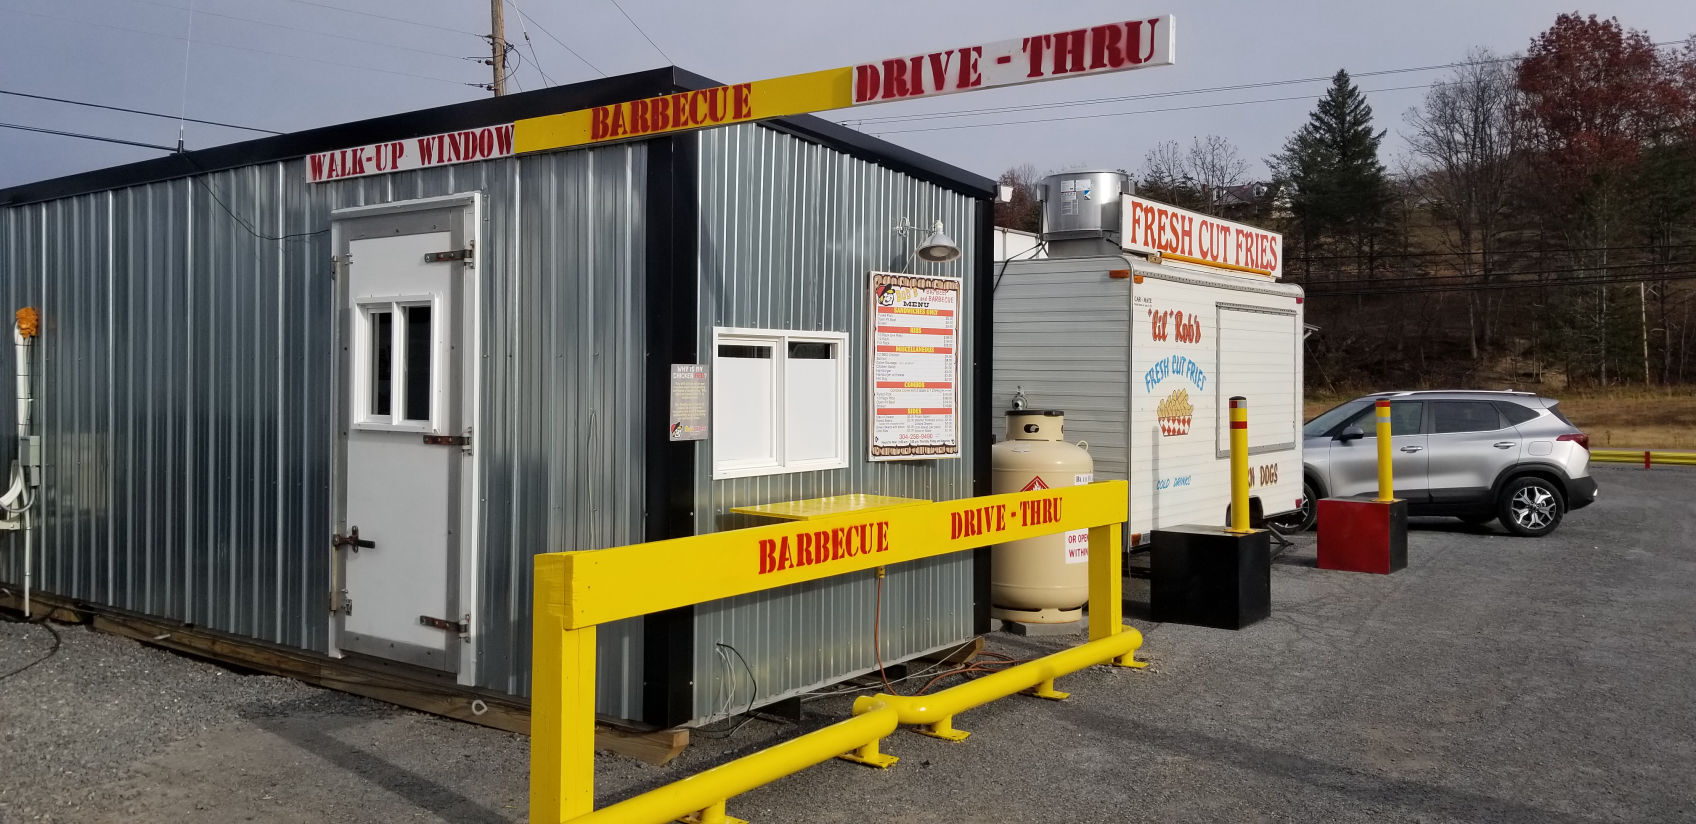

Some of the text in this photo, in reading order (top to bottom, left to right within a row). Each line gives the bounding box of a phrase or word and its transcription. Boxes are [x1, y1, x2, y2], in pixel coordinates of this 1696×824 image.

[855, 46, 983, 103] DRIVE
[1022, 18, 1159, 78] THRU
[590, 83, 752, 142] BARBECUE
[310, 124, 515, 181] WALK-UP WINDOW
[1131, 200, 1278, 272] FRESH CUT FRIES
[903, 300, 930, 308] MENU
[928, 295, 954, 304] BARBECUE
[1144, 354, 1207, 394] FRESH CUT FRIES
[1156, 478, 1170, 490] COLD
[1259, 462, 1279, 487] DOGS
[758, 521, 889, 575] BARBECUE
[950, 503, 1006, 540] DRIVE
[1019, 496, 1063, 527] THRU
[1068, 535, 1077, 544] OR
